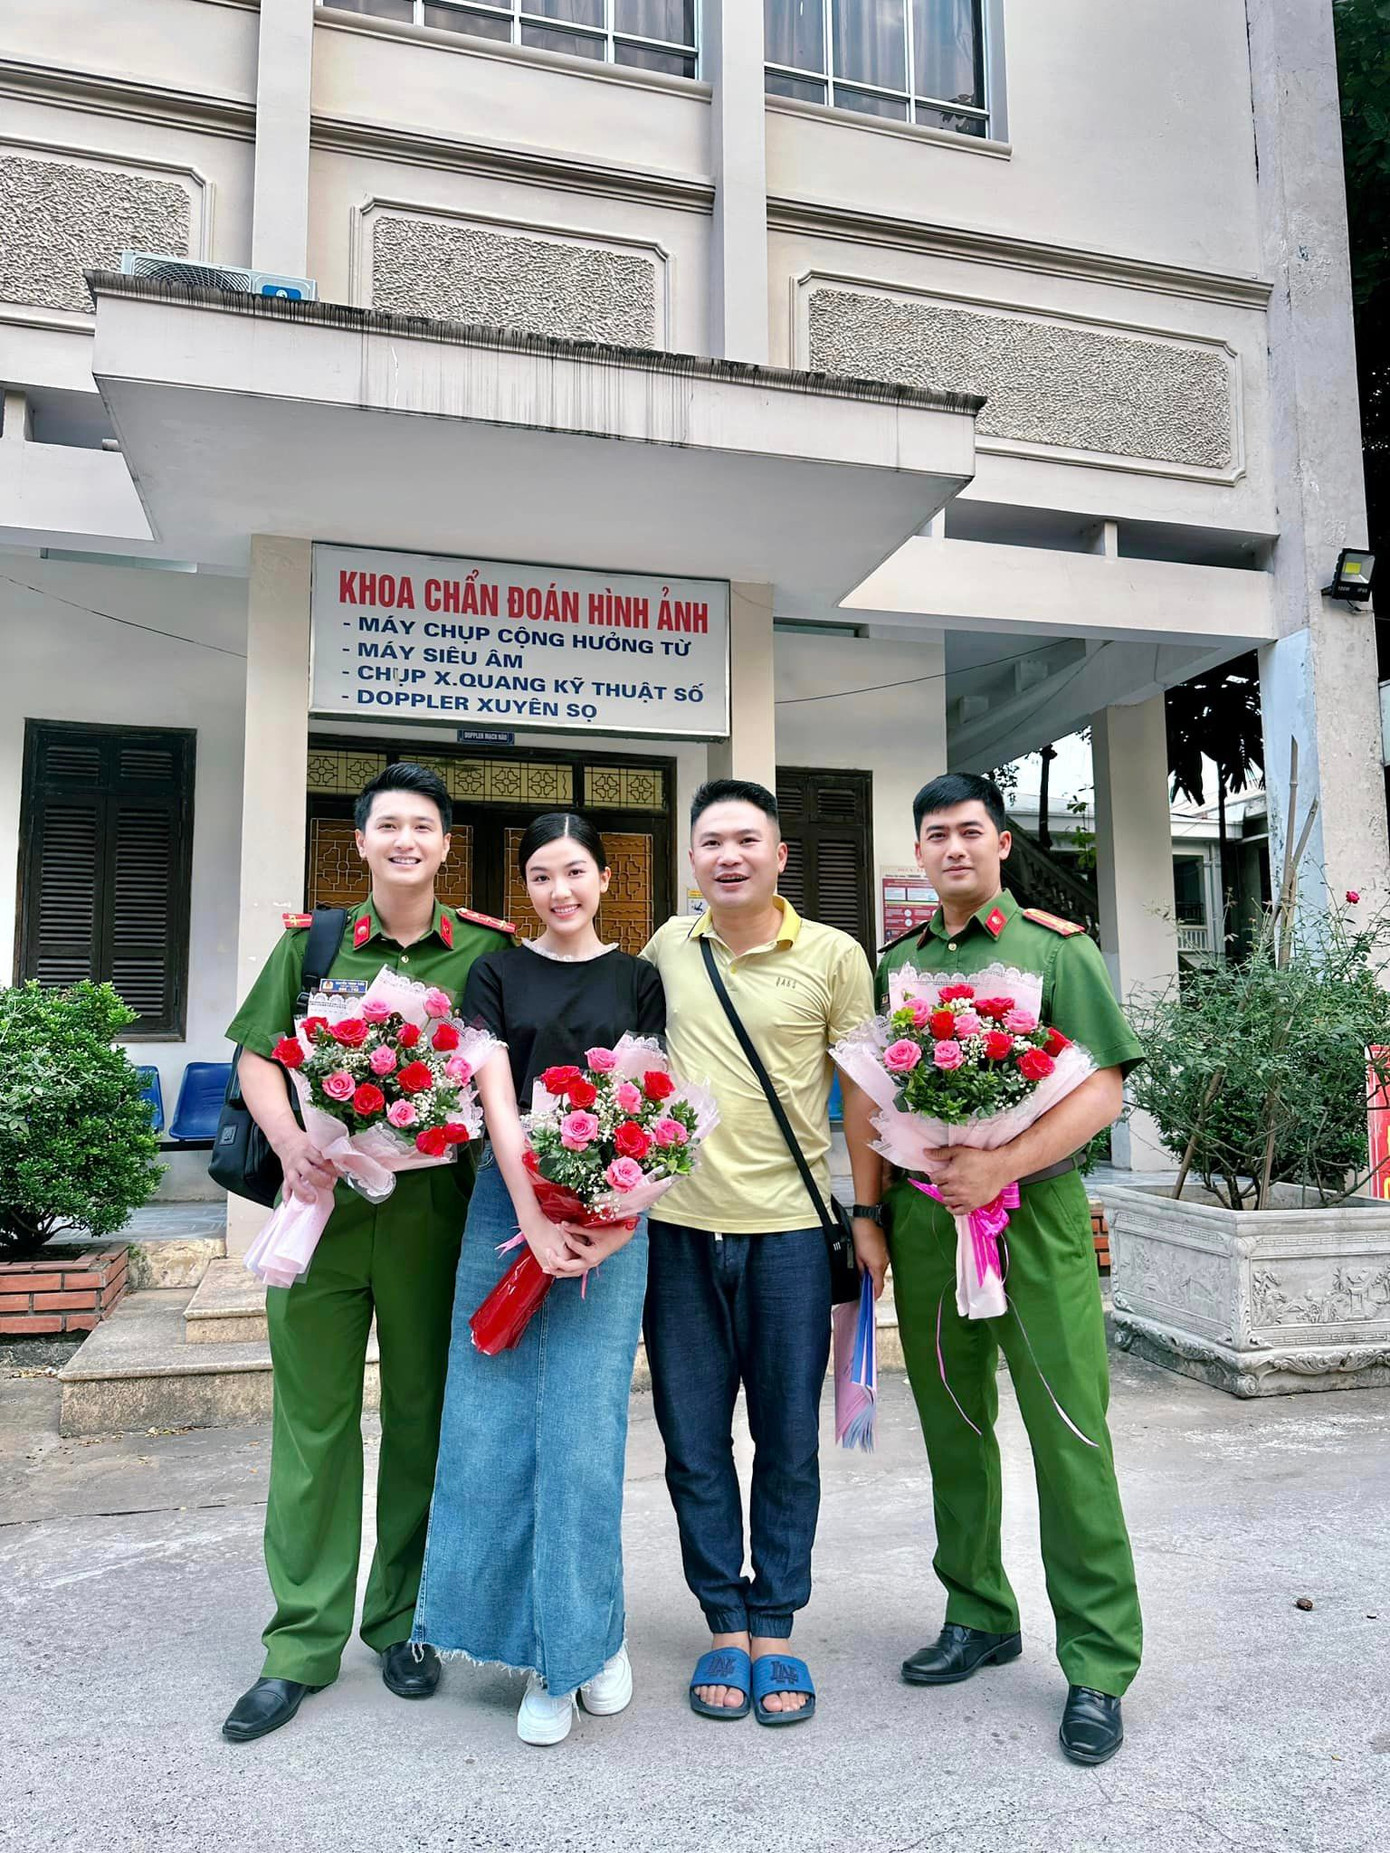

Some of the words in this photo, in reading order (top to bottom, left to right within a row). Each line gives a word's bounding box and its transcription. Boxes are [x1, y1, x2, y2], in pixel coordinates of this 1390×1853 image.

[339, 570, 415, 609] KHOA
[424, 569, 499, 617] CHẨN
[507, 583, 579, 624] ĐOÁN
[588, 588, 649, 629] HÌNH
[657, 586, 708, 634] ẢNH
[357, 641, 415, 660] MÁY
[423, 646, 477, 665] SIÊU
[485, 648, 523, 669] ÂM
[358, 615, 416, 635] MÁY
[424, 622, 490, 644] CHỤP
[498, 626, 565, 649] CỘNG
[572, 631, 654, 654] HƯỞNG
[660, 639, 692, 657] TỪ
[357, 665, 426, 687] CHỤP
[434, 670, 546, 692] X.QUANG
[554, 677, 585, 694] KỸ
[591, 682, 667, 703] THUẬT
[674, 682, 704, 703] SỐ
[357, 689, 469, 711] DOPPLER
[477, 697, 559, 717] XUYÊN
[566, 703, 597, 722] SỌ
